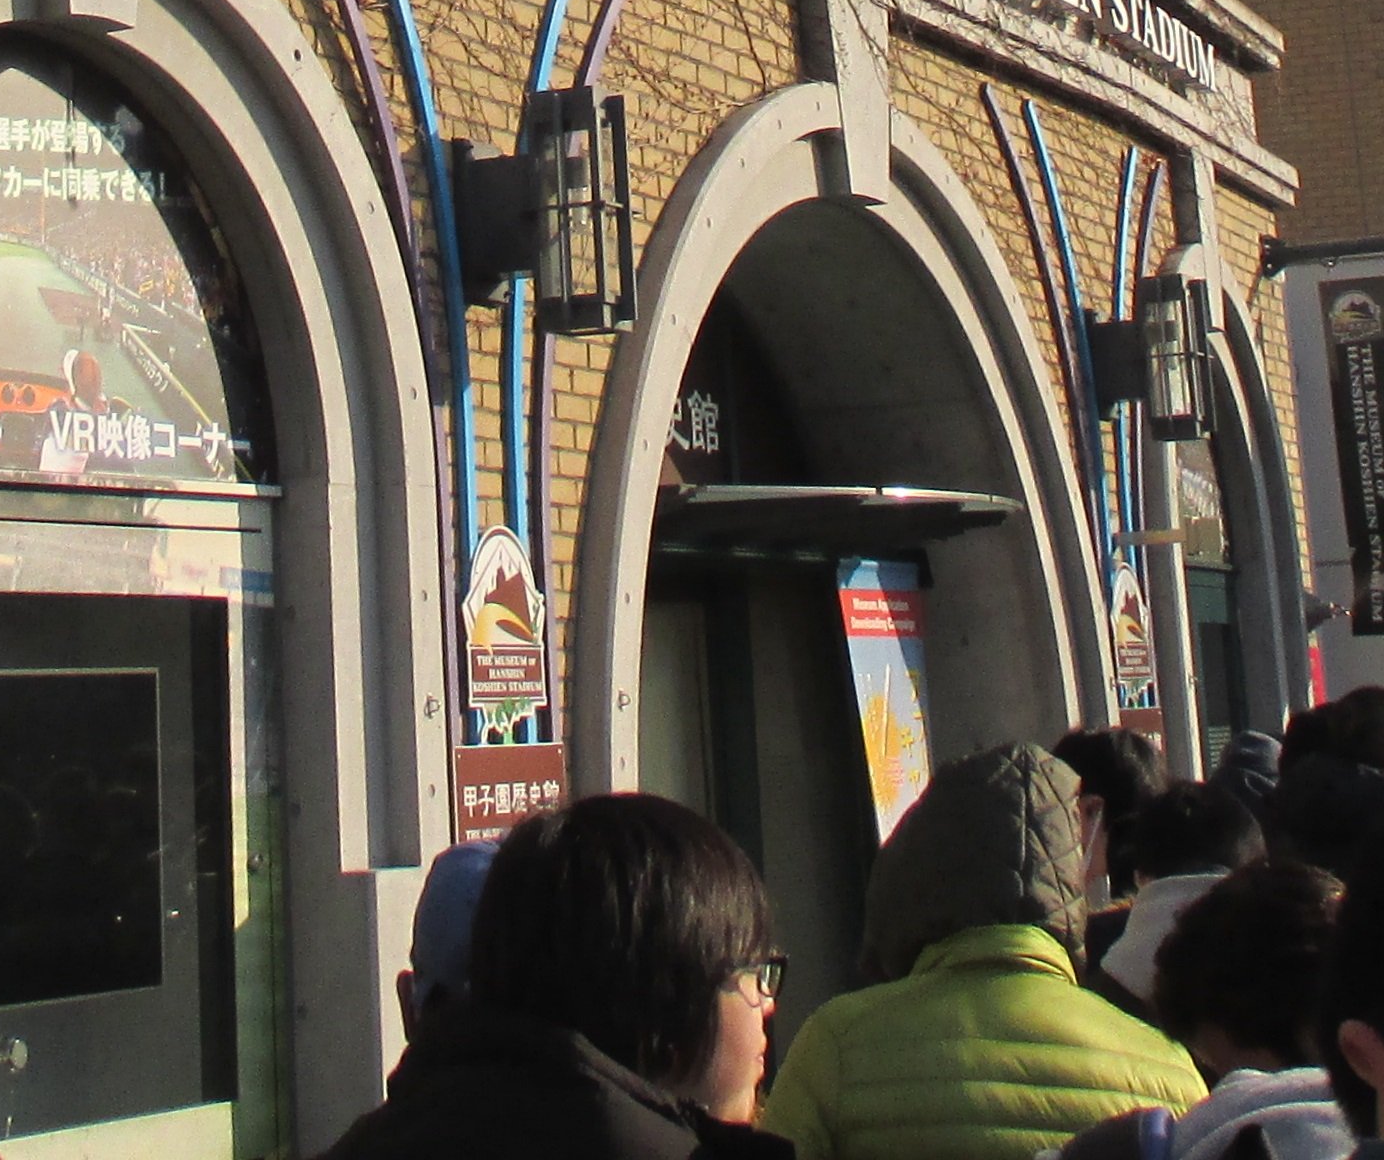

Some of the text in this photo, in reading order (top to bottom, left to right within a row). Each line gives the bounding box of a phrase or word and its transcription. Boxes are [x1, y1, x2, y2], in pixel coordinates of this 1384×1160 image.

[49, 409, 251, 461] VR映像コーナー
[1347, 346, 1367, 434] HANSHIN
[1357, 441, 1379, 528] KOSHIEN
[1364, 390, 1384, 474] MUSEUM
